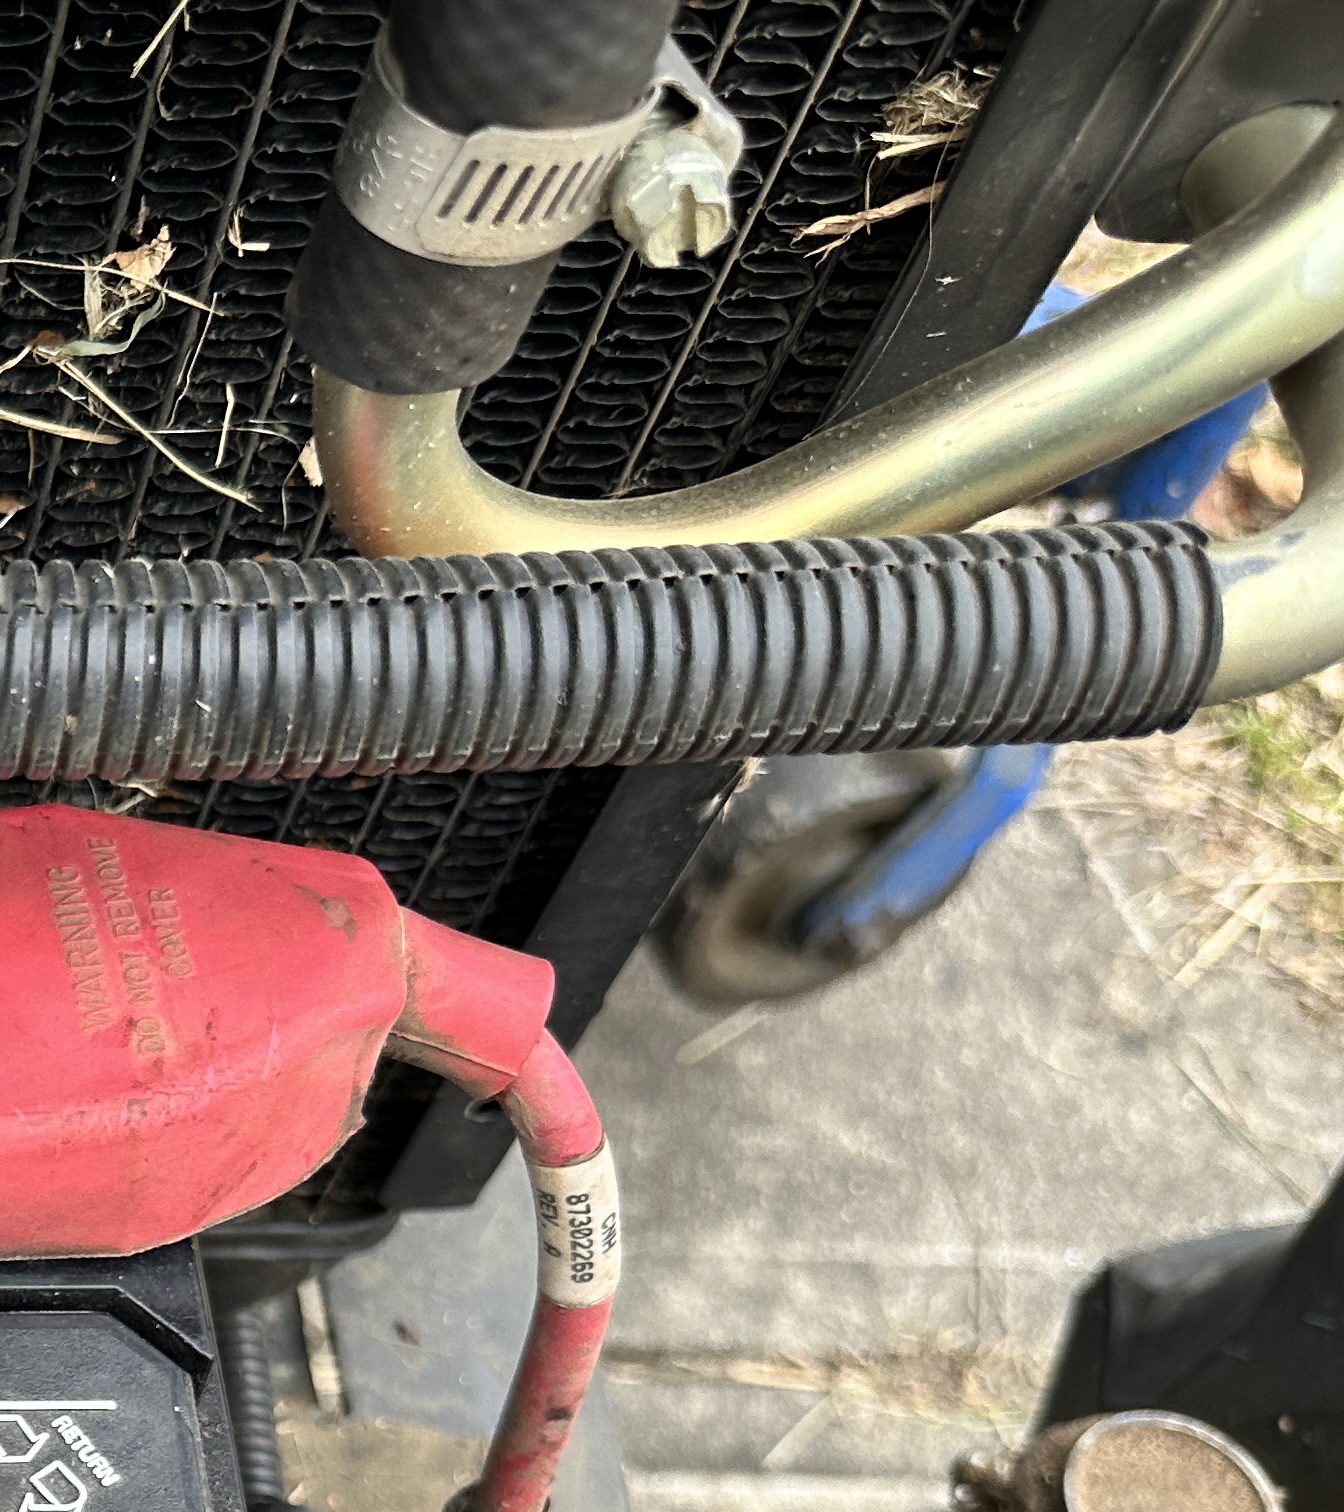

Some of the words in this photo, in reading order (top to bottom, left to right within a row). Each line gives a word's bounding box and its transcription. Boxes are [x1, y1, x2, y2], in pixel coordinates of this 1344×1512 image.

[87, 838, 141, 940] REMOVE
[46, 866, 114, 1030] WARNING
[148, 888, 193, 978] COVER
[119, 951, 156, 1006] NOT
[133, 1015, 165, 1056] DO
[536, 1188, 560, 1229] REV.
[565, 1193, 594, 1284] 87302269
[601, 1212, 617, 1255] CNH
[50, 1414, 121, 1487] RETURN
